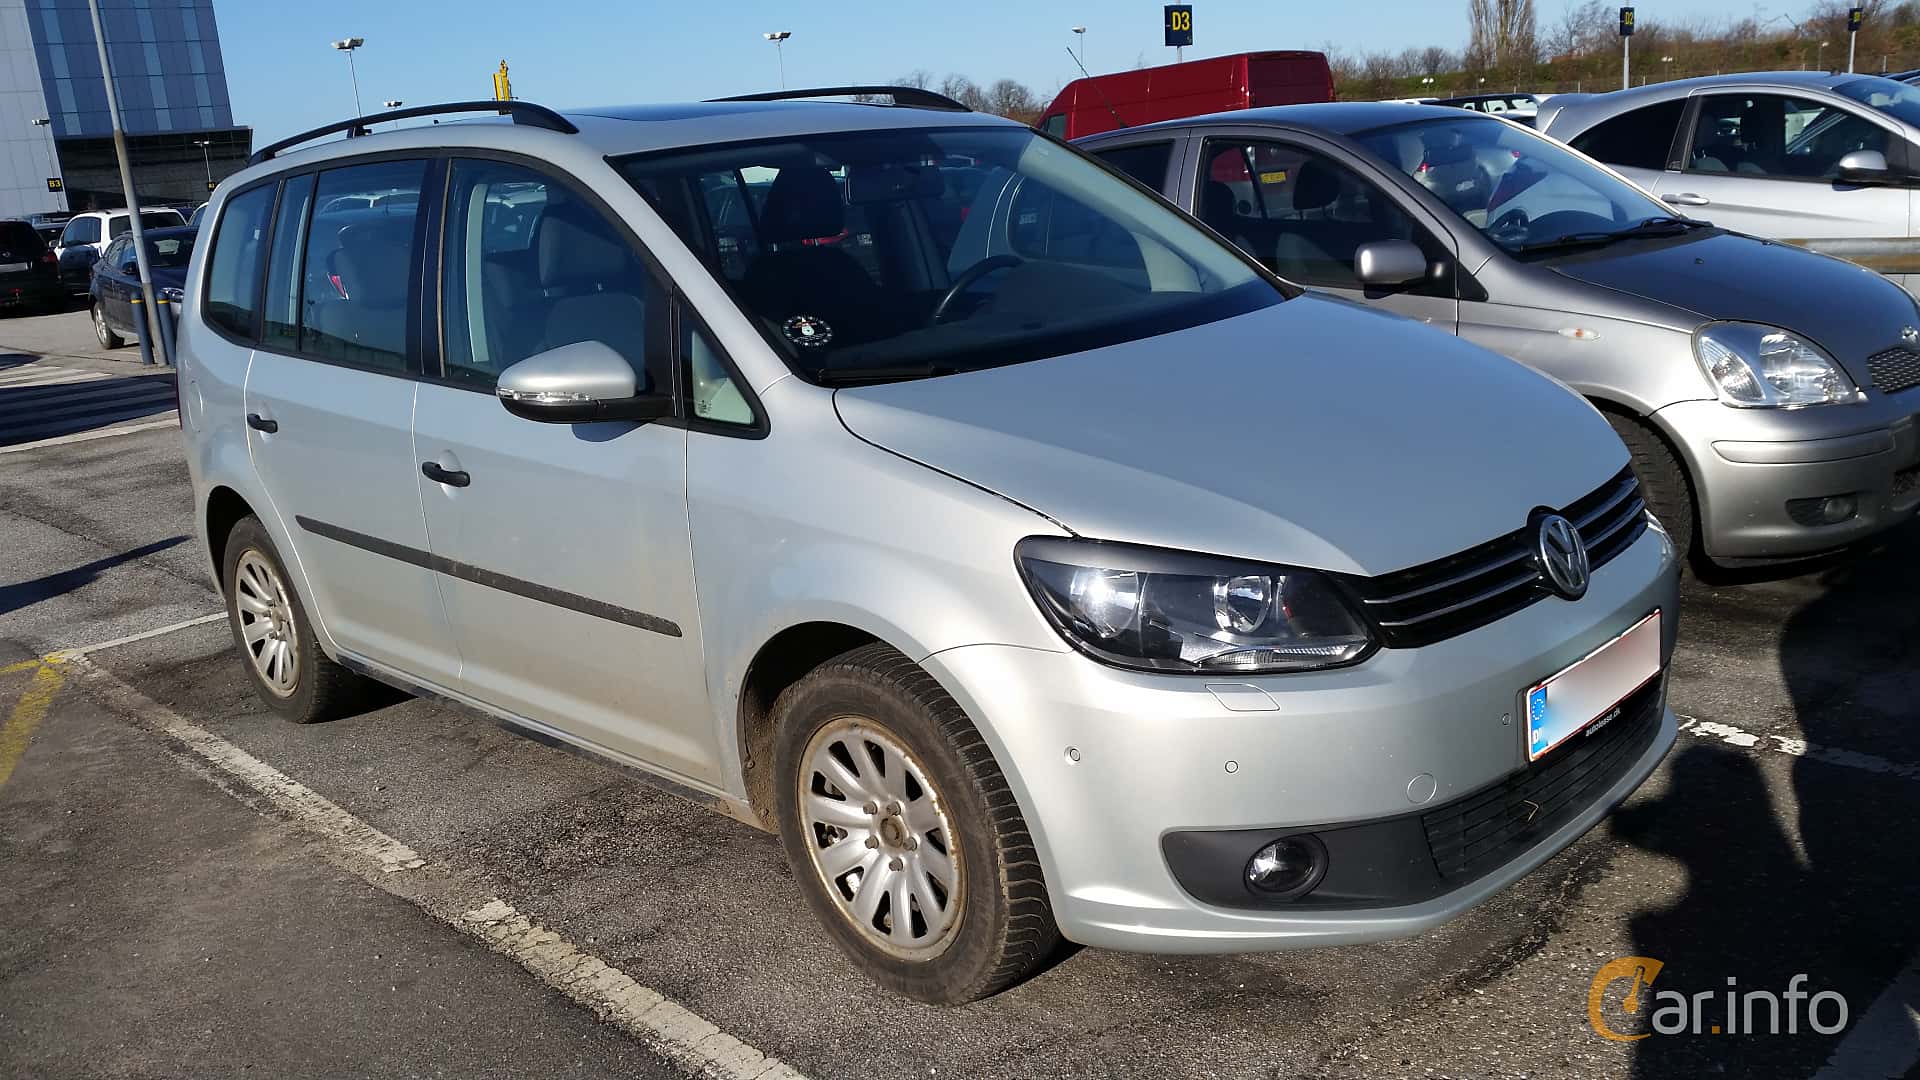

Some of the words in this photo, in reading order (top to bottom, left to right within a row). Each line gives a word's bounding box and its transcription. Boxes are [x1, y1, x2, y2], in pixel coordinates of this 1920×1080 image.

[1172, 11, 1190, 31] D3
[1625, 11, 1633, 25] D2
[49, 179, 61, 188] B3
